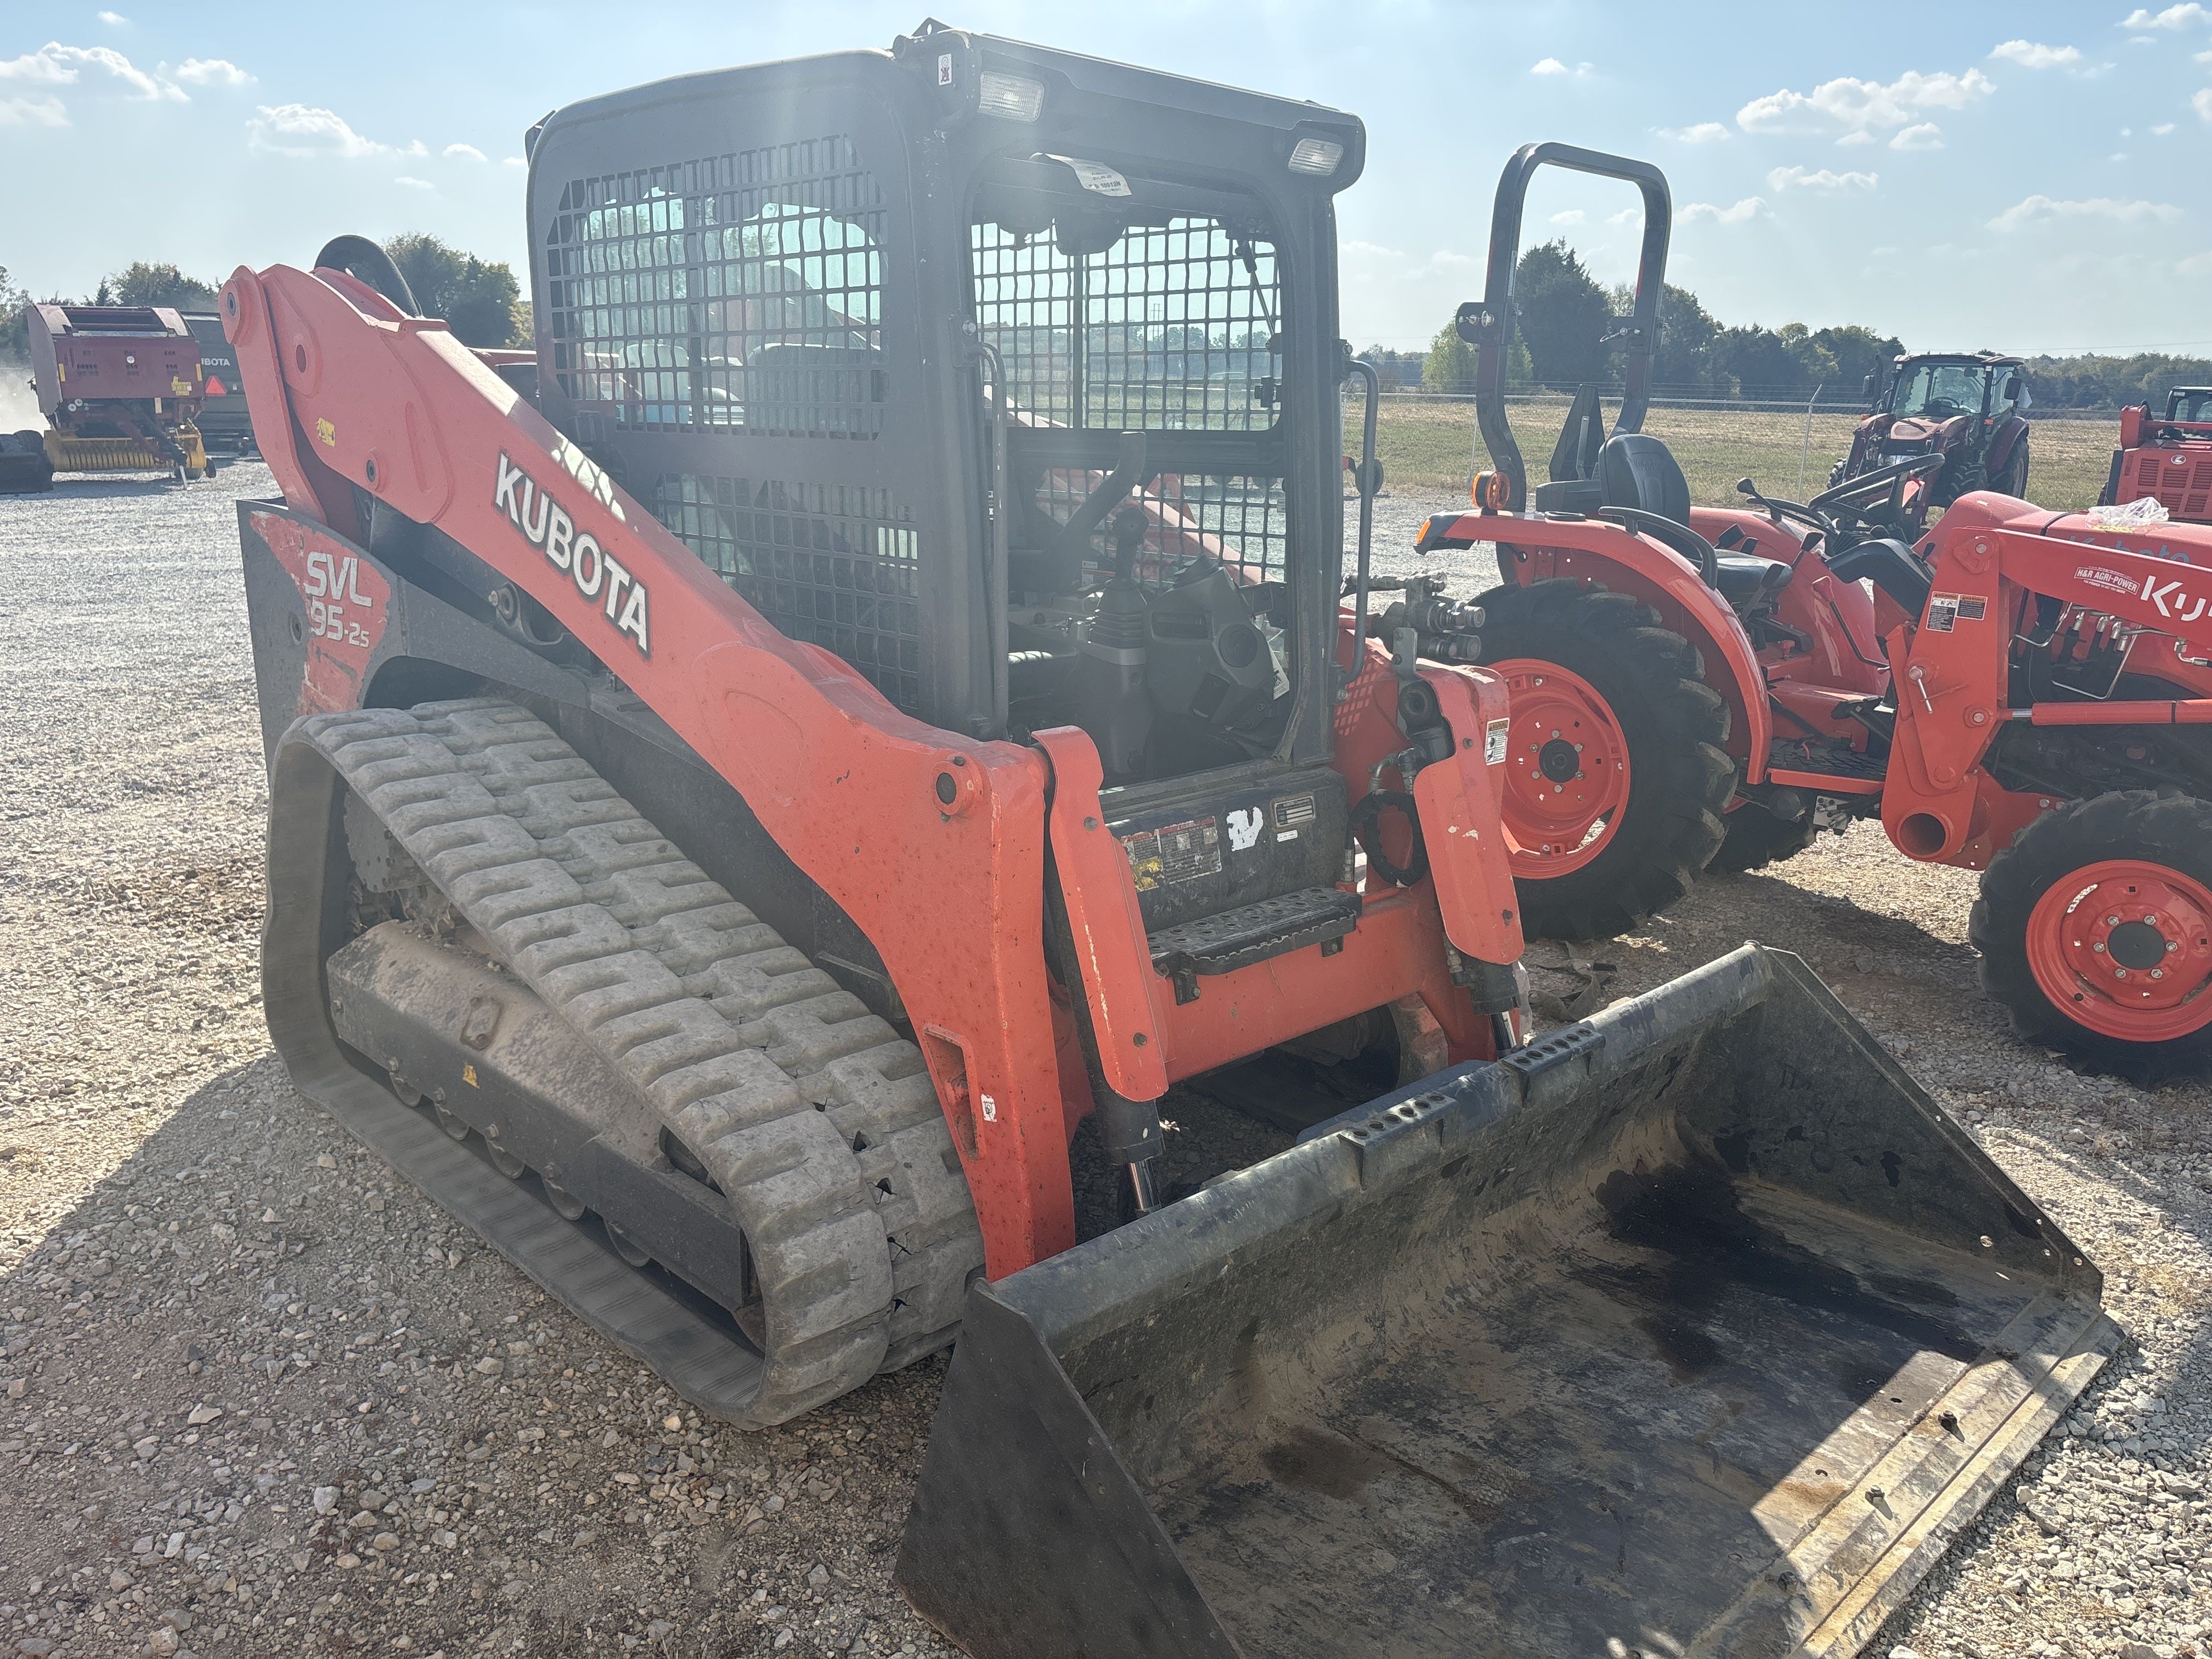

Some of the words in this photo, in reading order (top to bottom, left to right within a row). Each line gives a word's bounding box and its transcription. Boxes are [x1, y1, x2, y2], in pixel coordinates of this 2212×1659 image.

[303, 551, 373, 607] SVL
[495, 453, 647, 652] KUBOTA
[2076, 569, 2094, 578] H&R
[2094, 571, 2138, 592] AGRI-POWER
